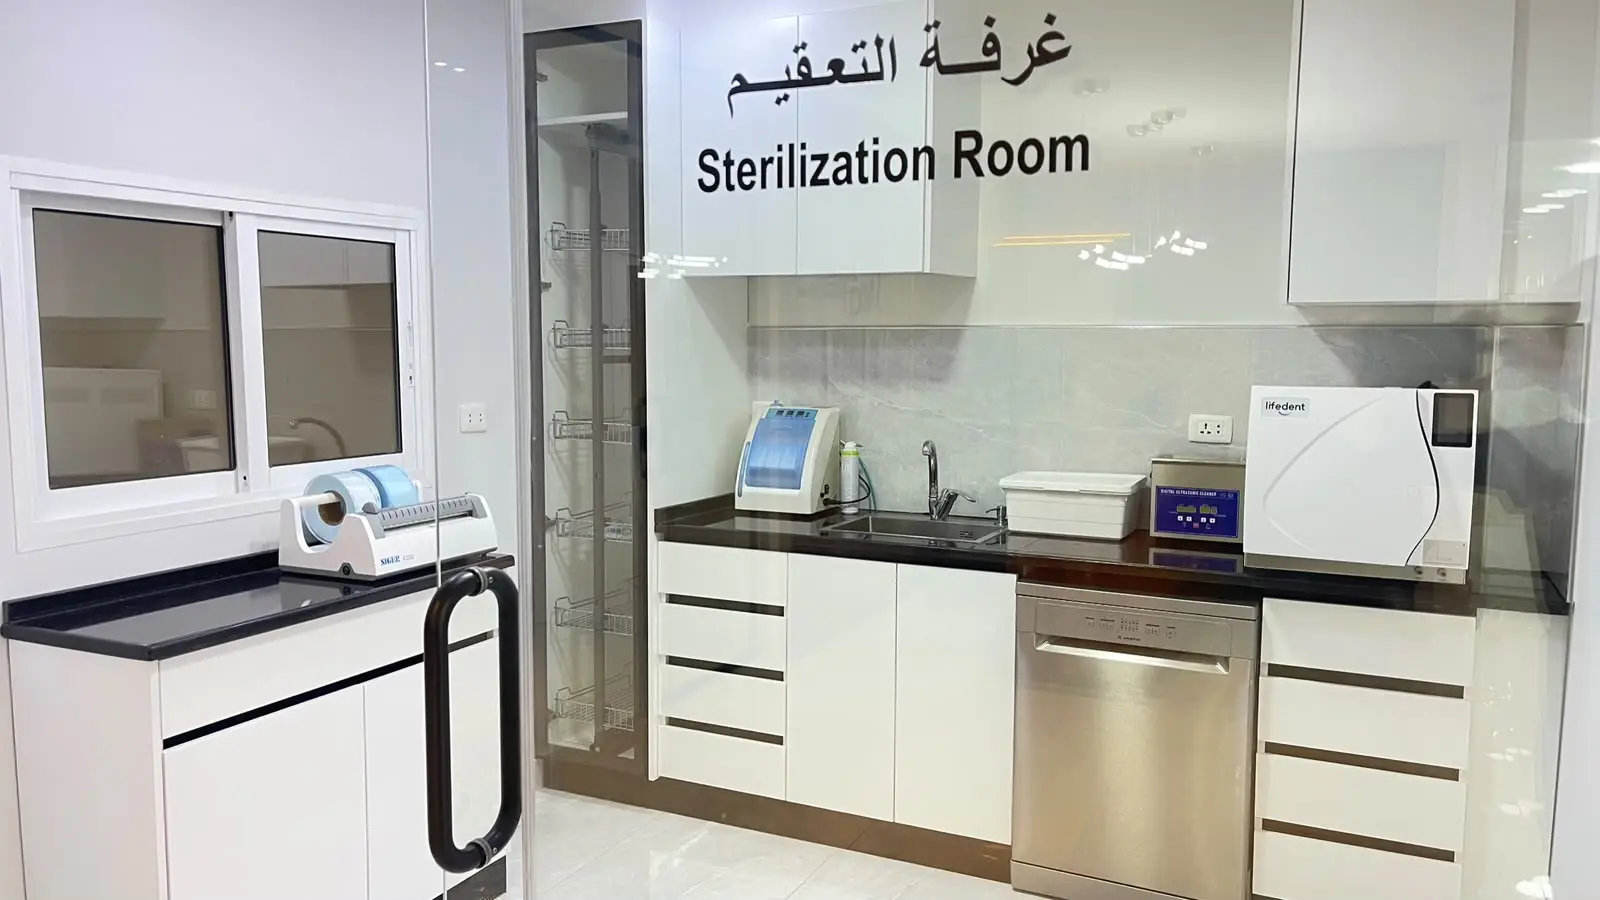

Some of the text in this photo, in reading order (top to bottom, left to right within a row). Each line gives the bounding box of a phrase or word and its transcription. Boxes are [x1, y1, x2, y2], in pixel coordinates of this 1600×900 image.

[727, 13, 1072, 118] غرفة التعقيم
[697, 129, 1090, 193] Sterilization Room
[1265, 401, 1306, 411] lifedent
